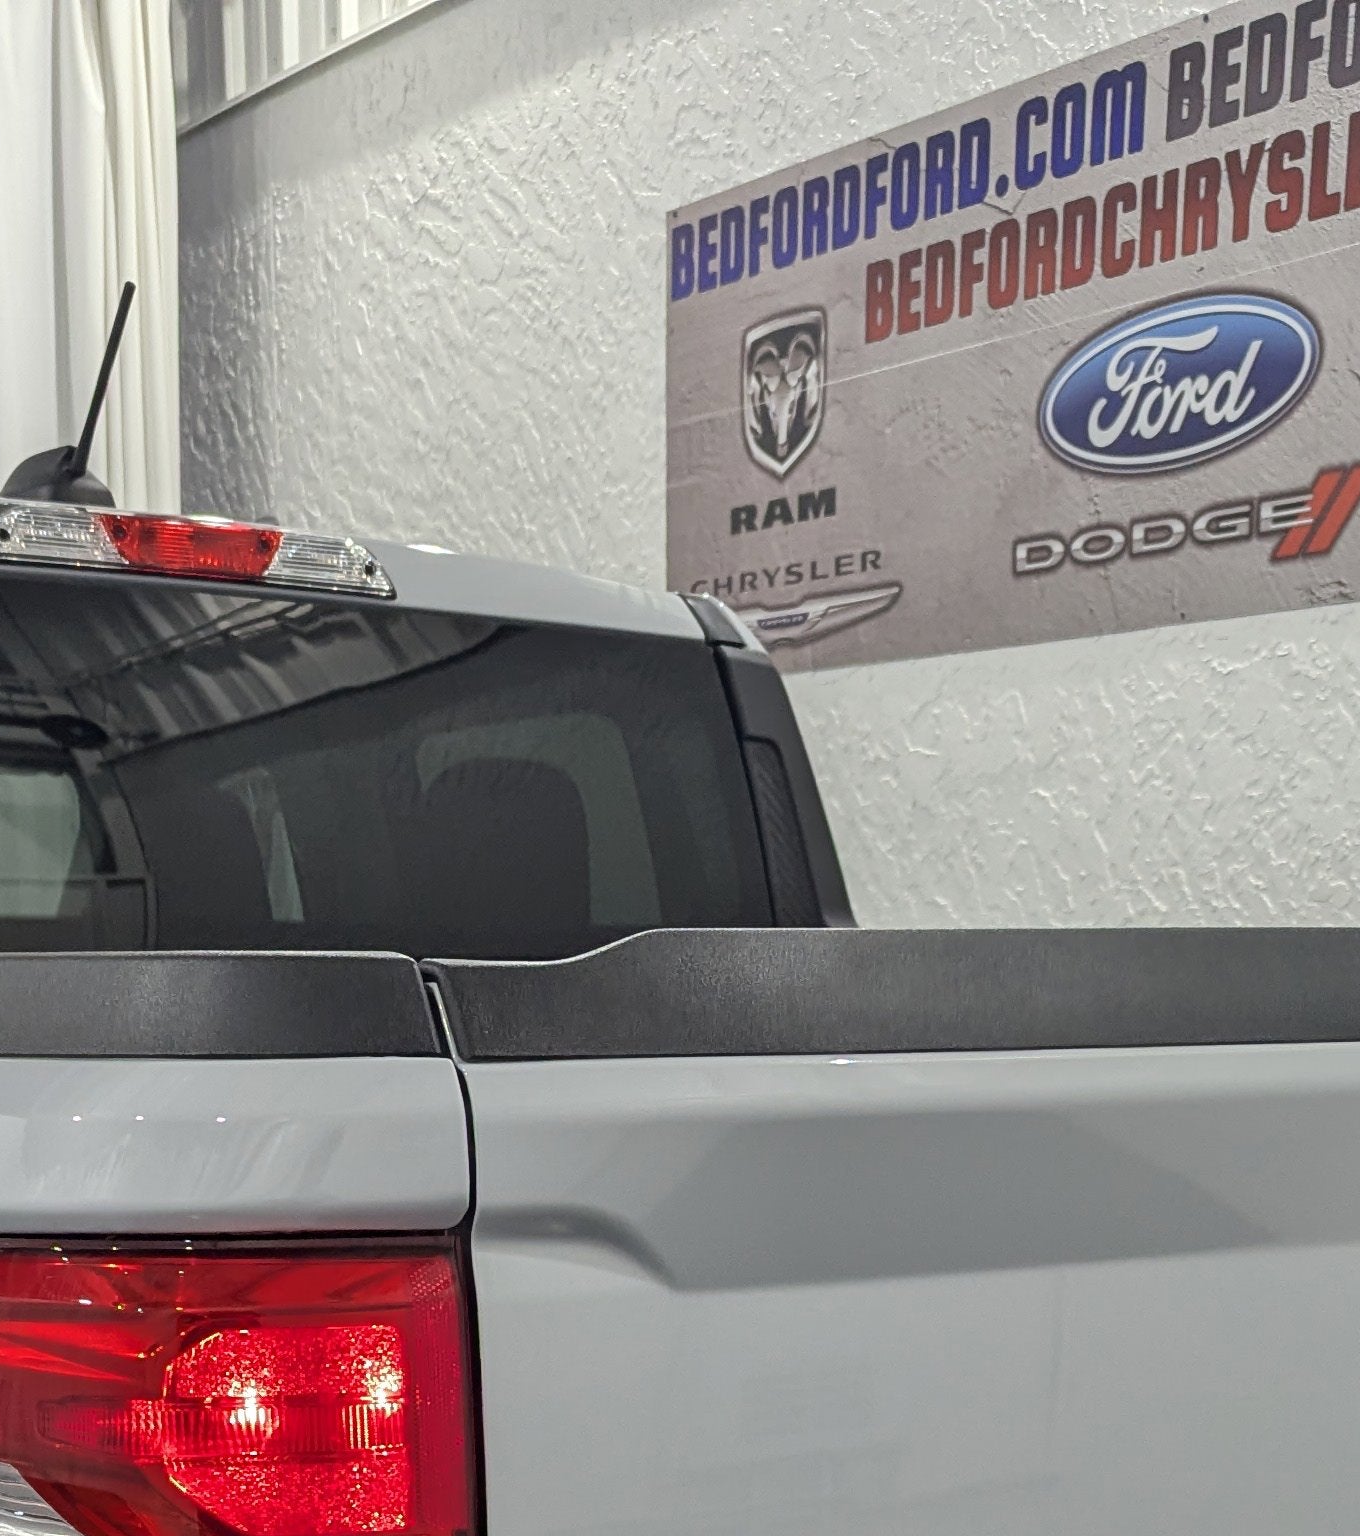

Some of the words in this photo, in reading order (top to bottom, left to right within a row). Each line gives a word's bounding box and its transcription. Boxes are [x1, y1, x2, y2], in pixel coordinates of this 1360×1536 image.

[670, 60, 1147, 301] BEDFORDFORD.COM
[1087, 325, 1264, 448] Ford
[730, 488, 837, 535] RAM
[1012, 494, 1317, 575] DODGE
[691, 549, 882, 597] CHRYSLER
